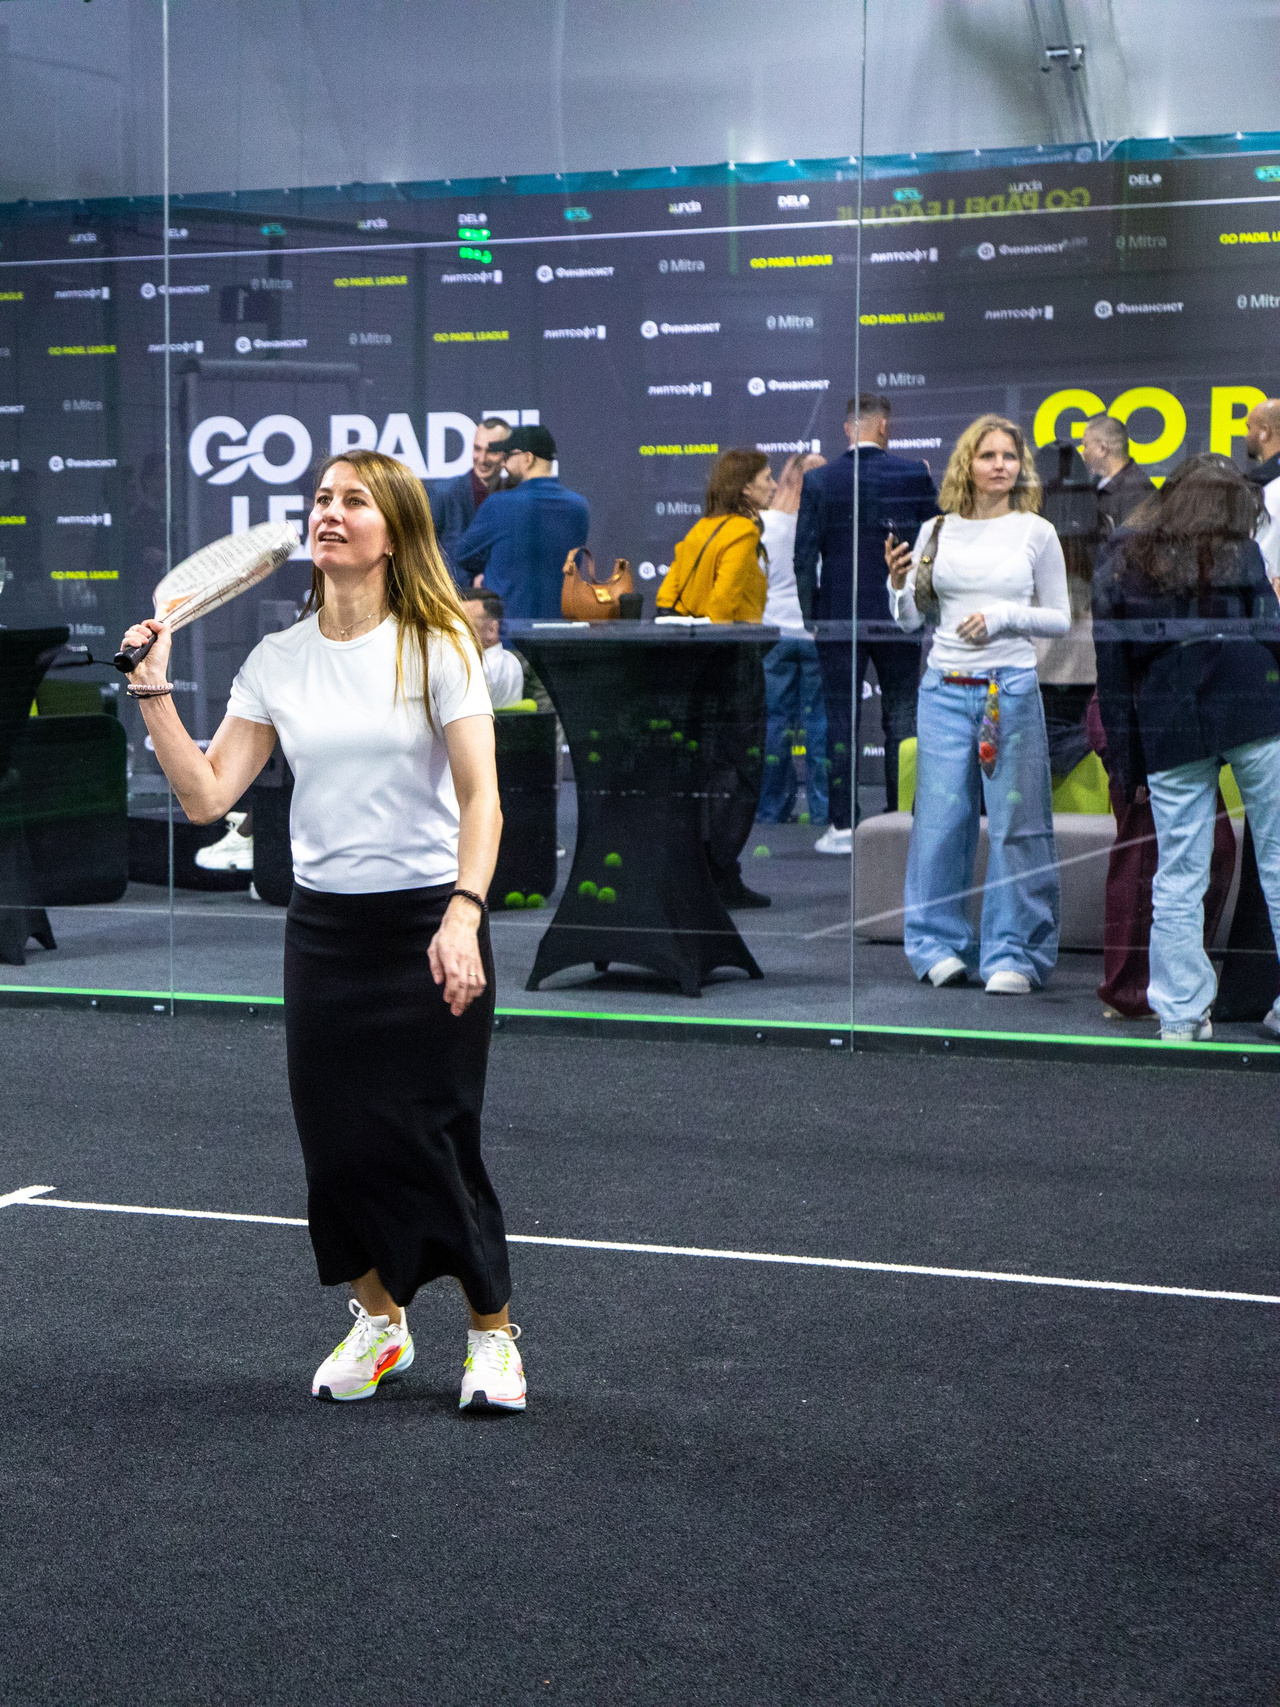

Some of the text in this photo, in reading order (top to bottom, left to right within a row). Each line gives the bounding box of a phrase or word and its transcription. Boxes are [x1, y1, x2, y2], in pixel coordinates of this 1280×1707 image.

[1129, 235, 1167, 249] Mitra
[1220, 233, 1238, 244] GO
[1239, 232, 1271, 243] PADEL
[670, 259, 705, 272] Mitra
[750, 254, 833, 269] GO PADEL LEAGUE
[555, 266, 614, 278] Финансист
[1250, 294, 1280, 308] Mitr
[1117, 302, 1184, 314] Финансист
[778, 315, 814, 329] Mitra
[860, 312, 945, 325] GO PADEL LEAGUE
[659, 322, 720, 334] Финансист
[433, 330, 509, 342] GO PADEL LEAGUE
[768, 379, 830, 391] Финансист
[889, 372, 926, 386] Mitra
[189, 414, 312, 485] GO
[639, 443, 719, 456] GO PADEL LEAGUE
[887, 438, 942, 449] инансист
[668, 502, 702, 515] Mitra
